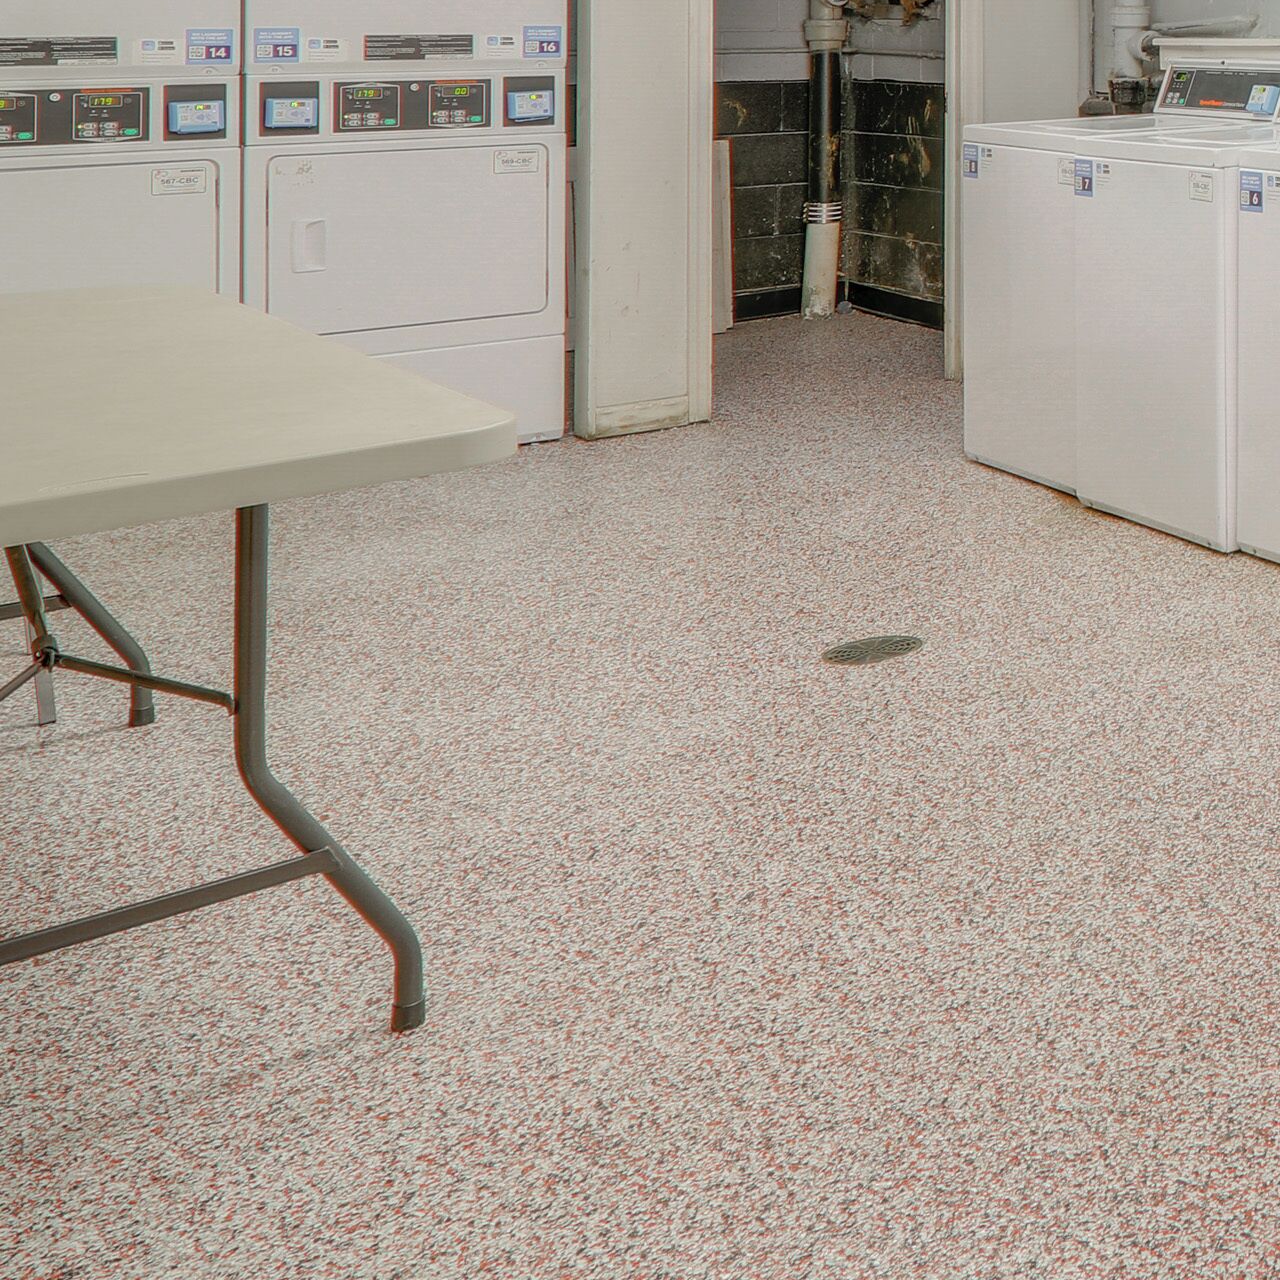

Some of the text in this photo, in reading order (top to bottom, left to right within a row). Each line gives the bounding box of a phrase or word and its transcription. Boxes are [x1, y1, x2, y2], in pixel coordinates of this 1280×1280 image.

[209, 47, 227, 58] 14
[276, 45, 293, 57] 15
[541, 42, 556, 52] 16
[93, 98, 112, 106] 179
[1083, 179, 1089, 190] 7
[1252, 193, 1259, 205] 6
